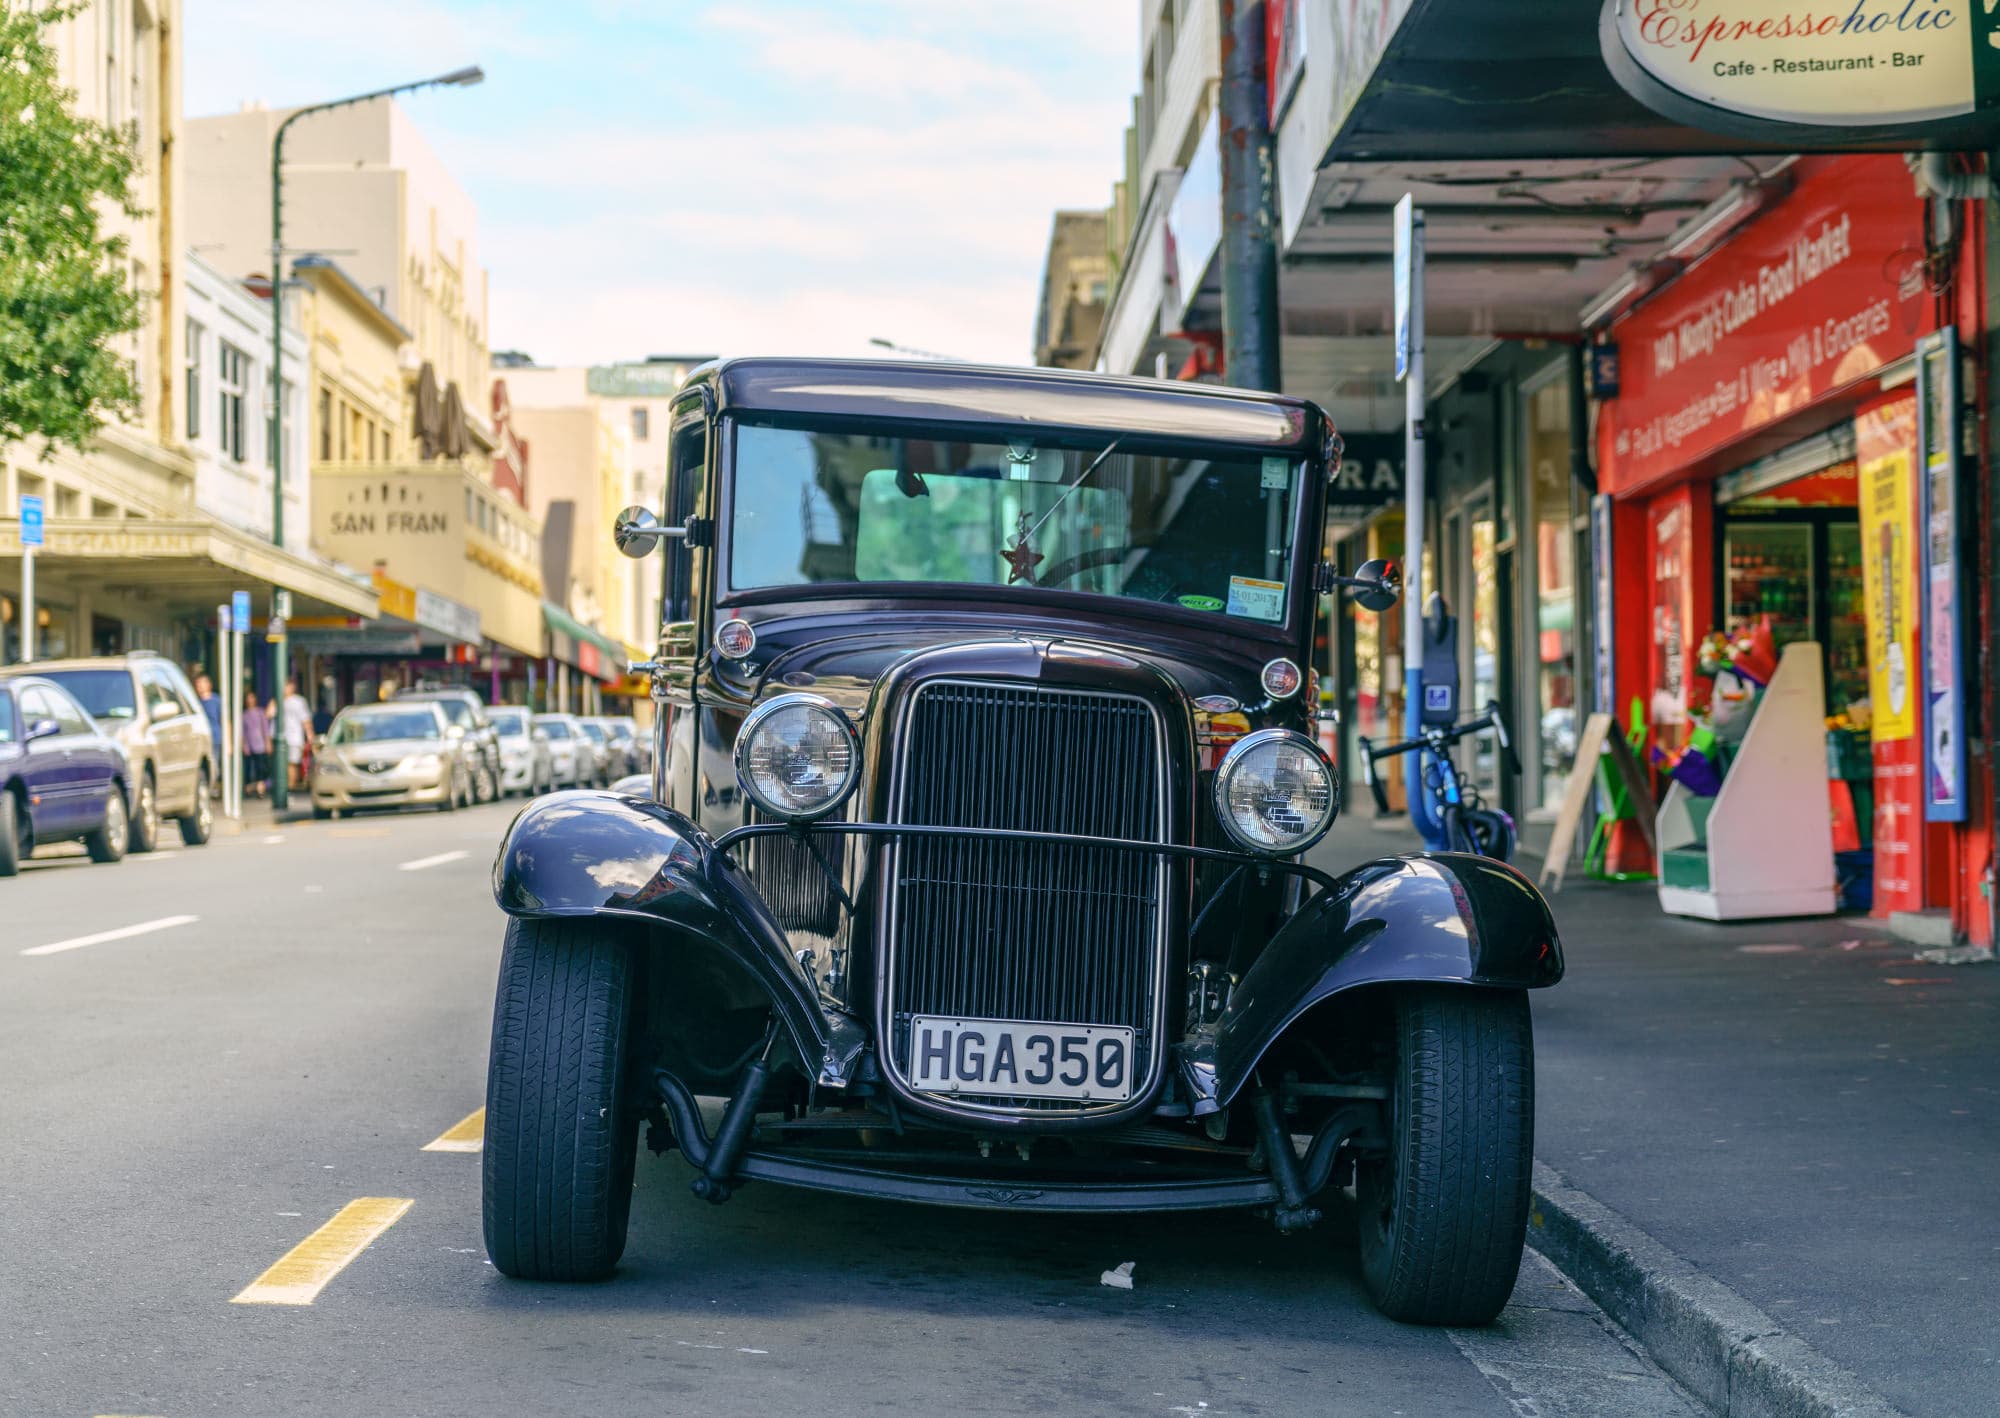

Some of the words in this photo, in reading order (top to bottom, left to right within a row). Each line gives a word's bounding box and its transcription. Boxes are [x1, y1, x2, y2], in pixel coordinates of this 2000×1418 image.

[1640, 0, 1956, 62] Espressoholic
[1713, 61, 1755, 77] Cafe
[1773, 53, 1875, 75] Restaurant
[1892, 52, 1925, 68] Bar
[1759, 246, 1795, 313] Food
[1796, 212, 1851, 287] Market
[330, 512, 374, 534] SAN
[386, 512, 446, 534] FRAN
[920, 1029, 1124, 1088] HGA350
